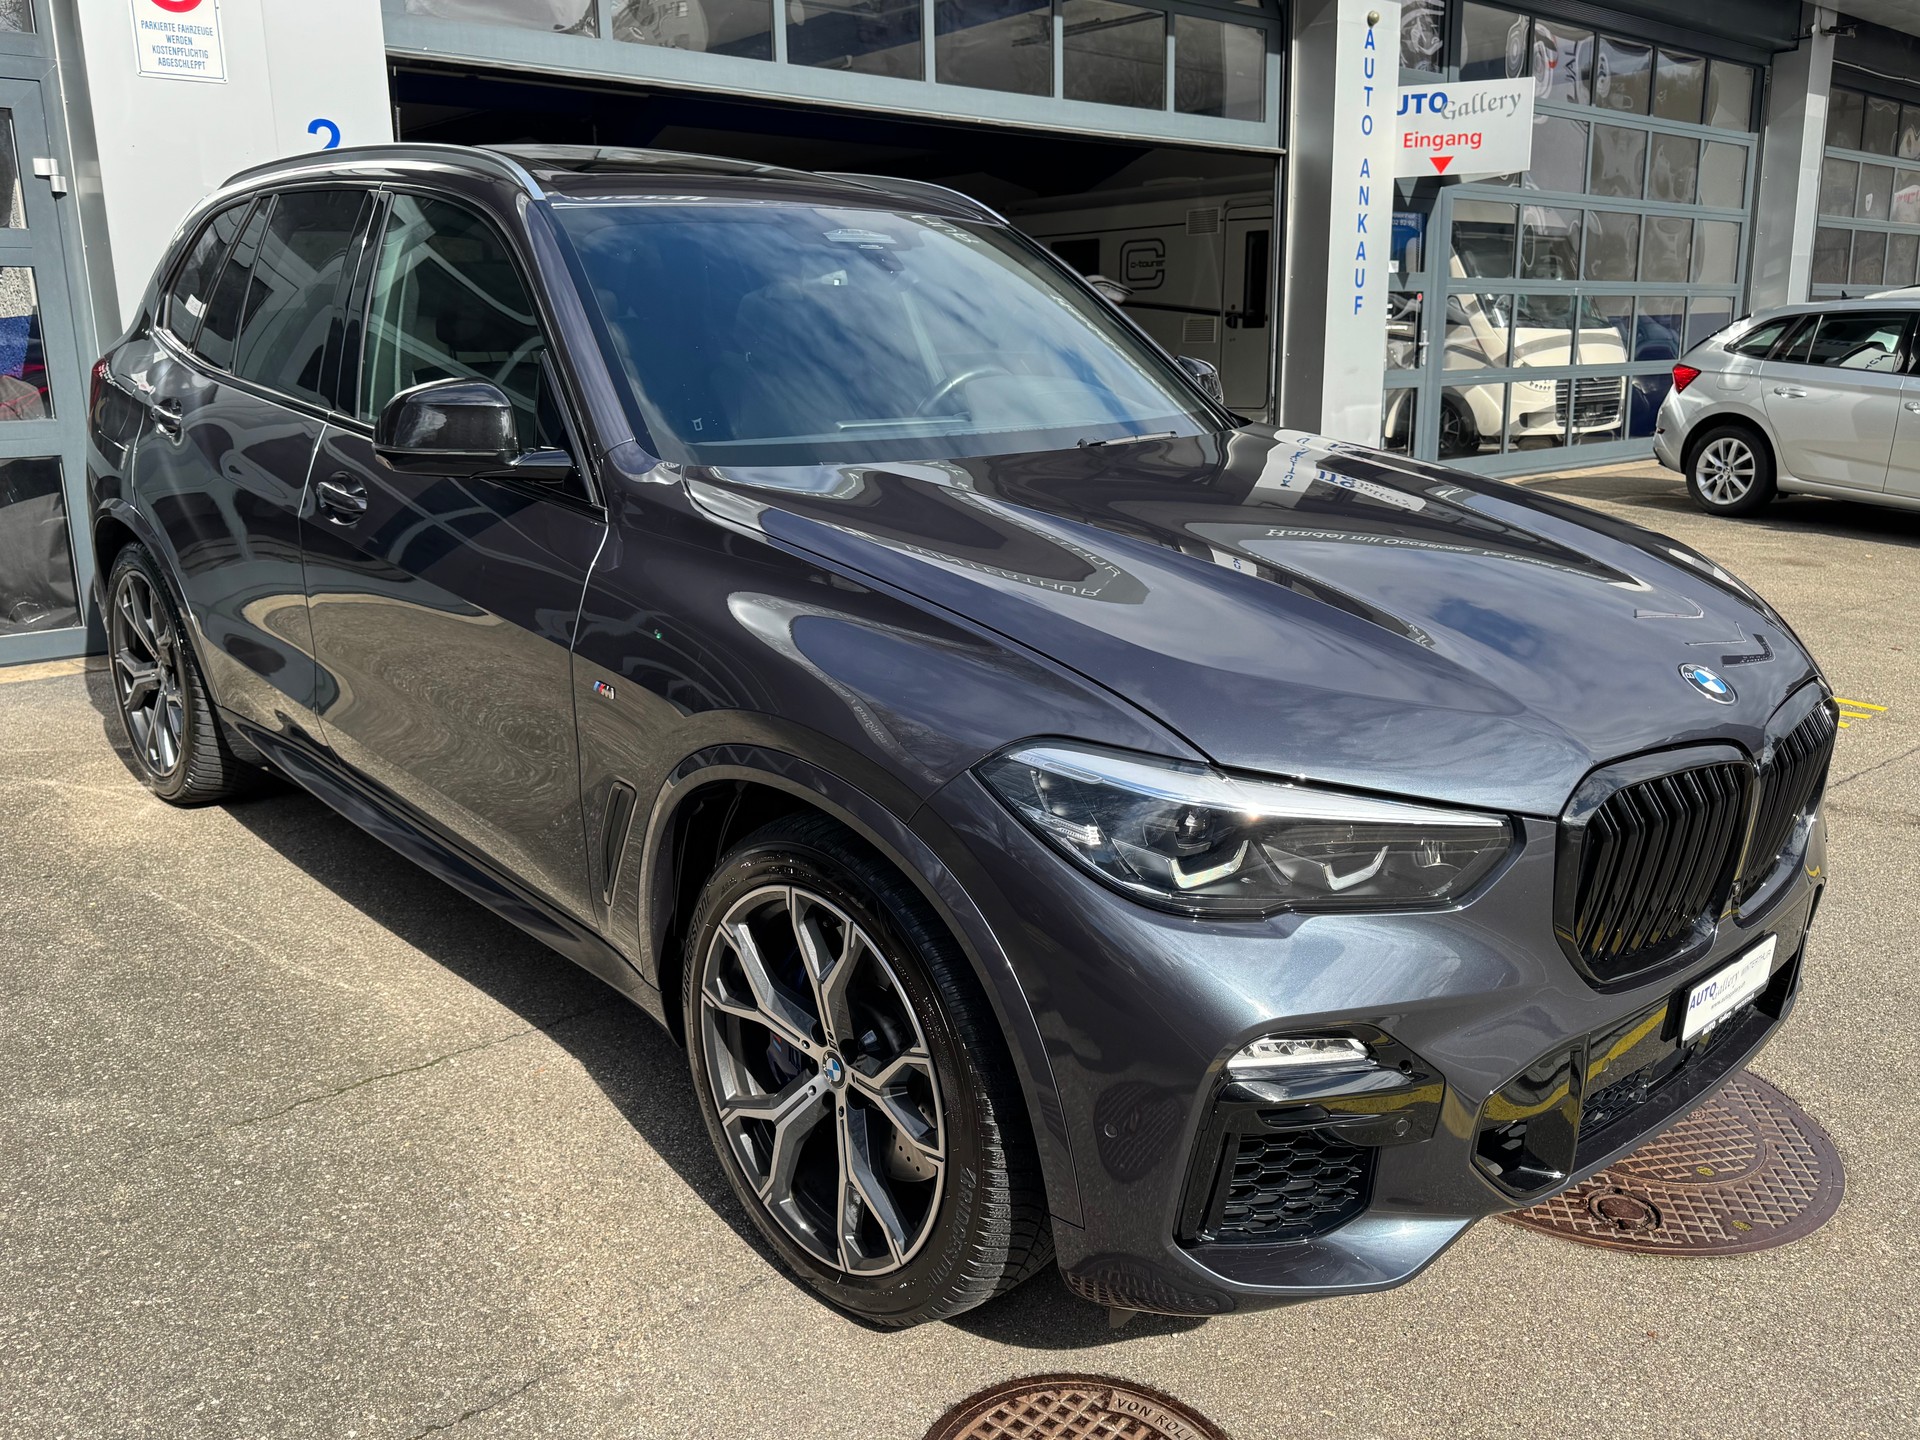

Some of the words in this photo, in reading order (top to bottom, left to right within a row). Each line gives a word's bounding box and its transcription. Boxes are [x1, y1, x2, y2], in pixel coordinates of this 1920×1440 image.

[140, 20, 176, 33] PARKIERTE
[177, 24, 214, 36] FAHRZEUGE
[165, 34, 193, 46] WERDEN
[152, 45, 209, 59] KOSTENPFLICHTIG
[158, 57, 206, 70] ABGESCHLEPPT
[1361, 29, 1376, 136] AUTO
[1441, 92, 1521, 120] Gallery
[307, 118, 340, 150] 2
[1403, 131, 1482, 152] Eingang
[1354, 158, 1370, 315] ANKAUF
[1689, 981, 1718, 1012] AUTO
[1116, 1398, 1152, 1418] VON
